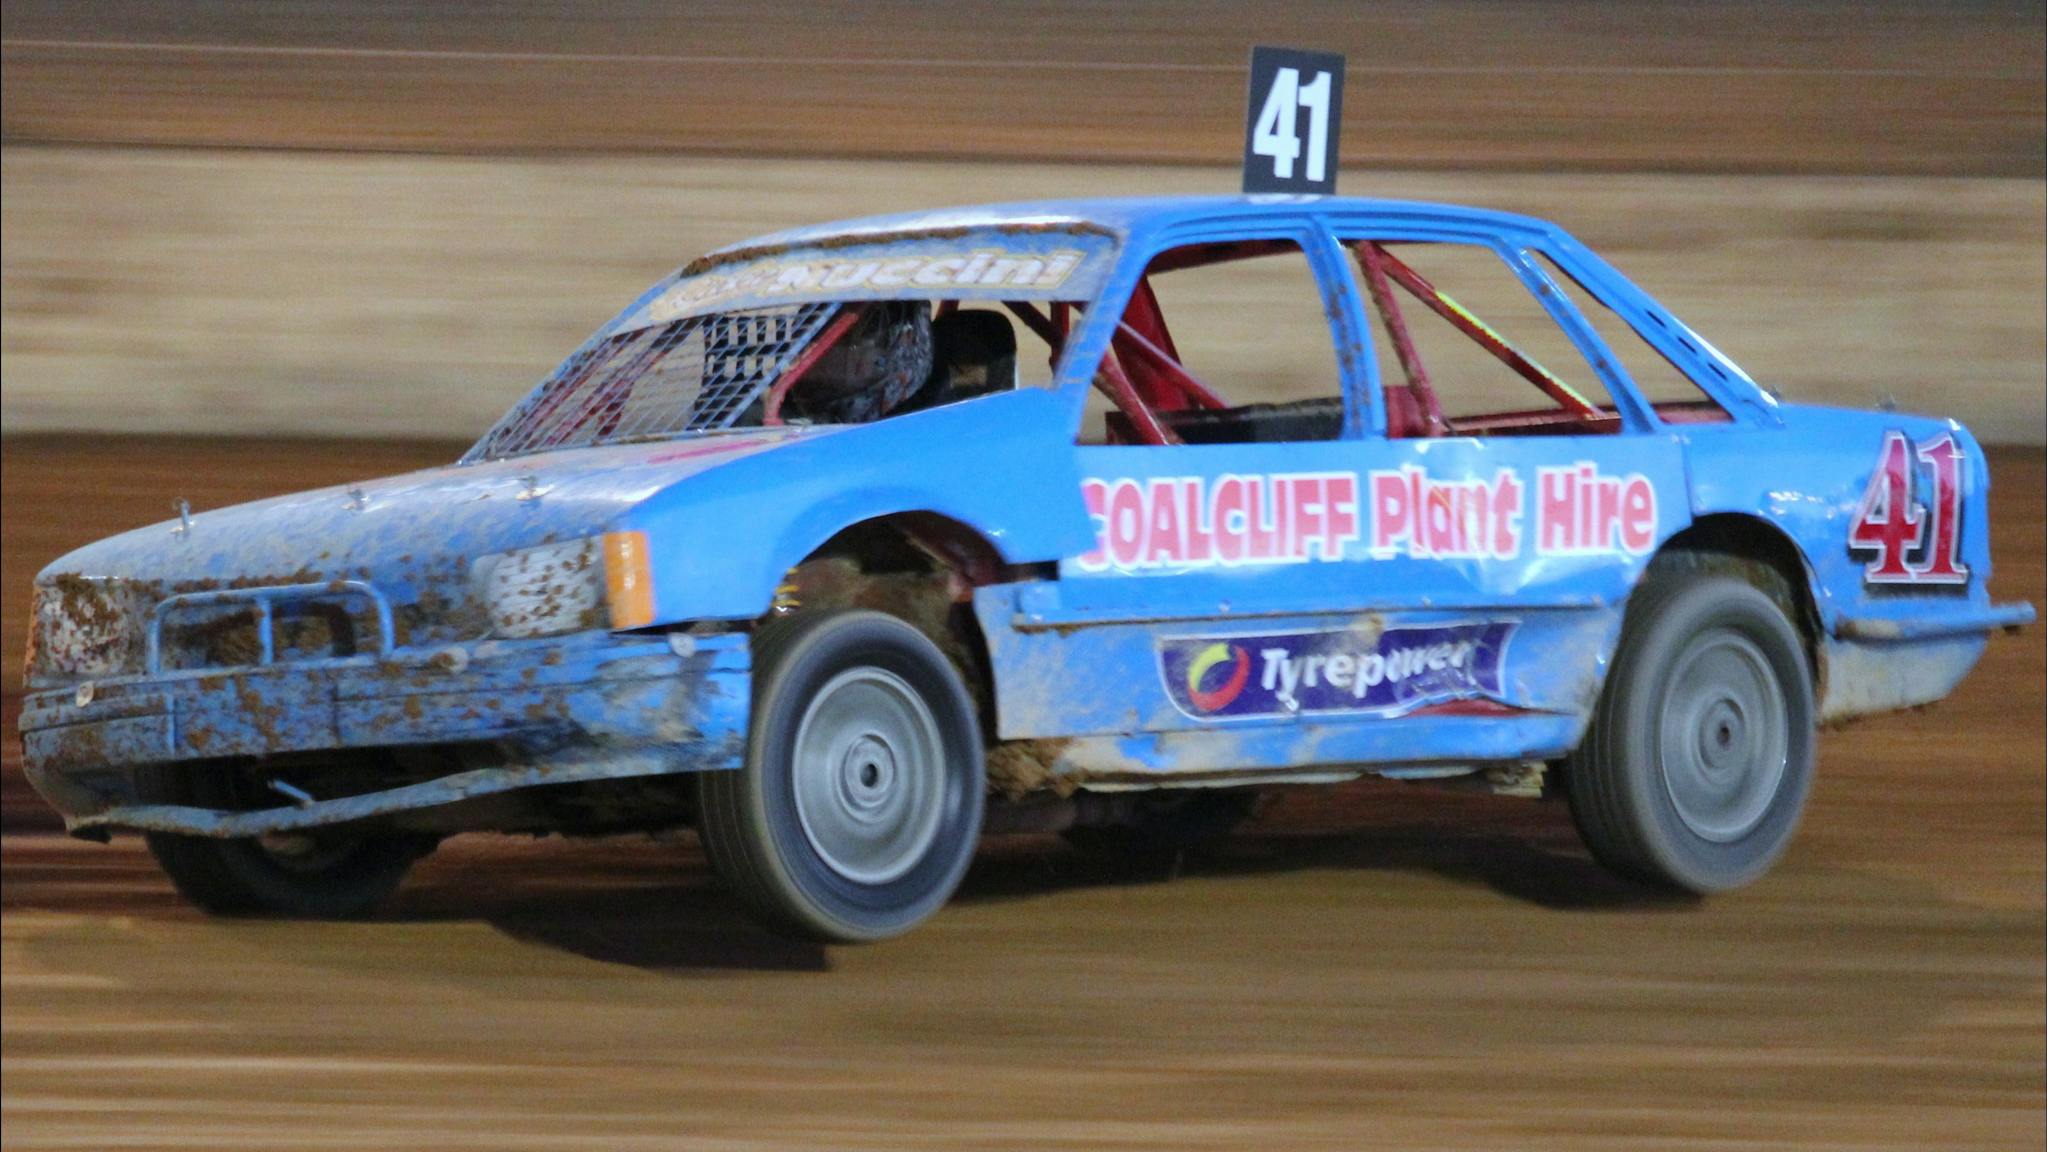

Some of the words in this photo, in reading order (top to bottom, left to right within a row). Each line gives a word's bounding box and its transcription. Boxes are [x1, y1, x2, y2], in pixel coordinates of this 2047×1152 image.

[1253, 67, 1331, 182] 41
[1368, 464, 1523, 560] Plant
[1538, 461, 1656, 556] Hire
[1848, 431, 1969, 588] 41
[1261, 642, 1474, 711] Tyrepower
